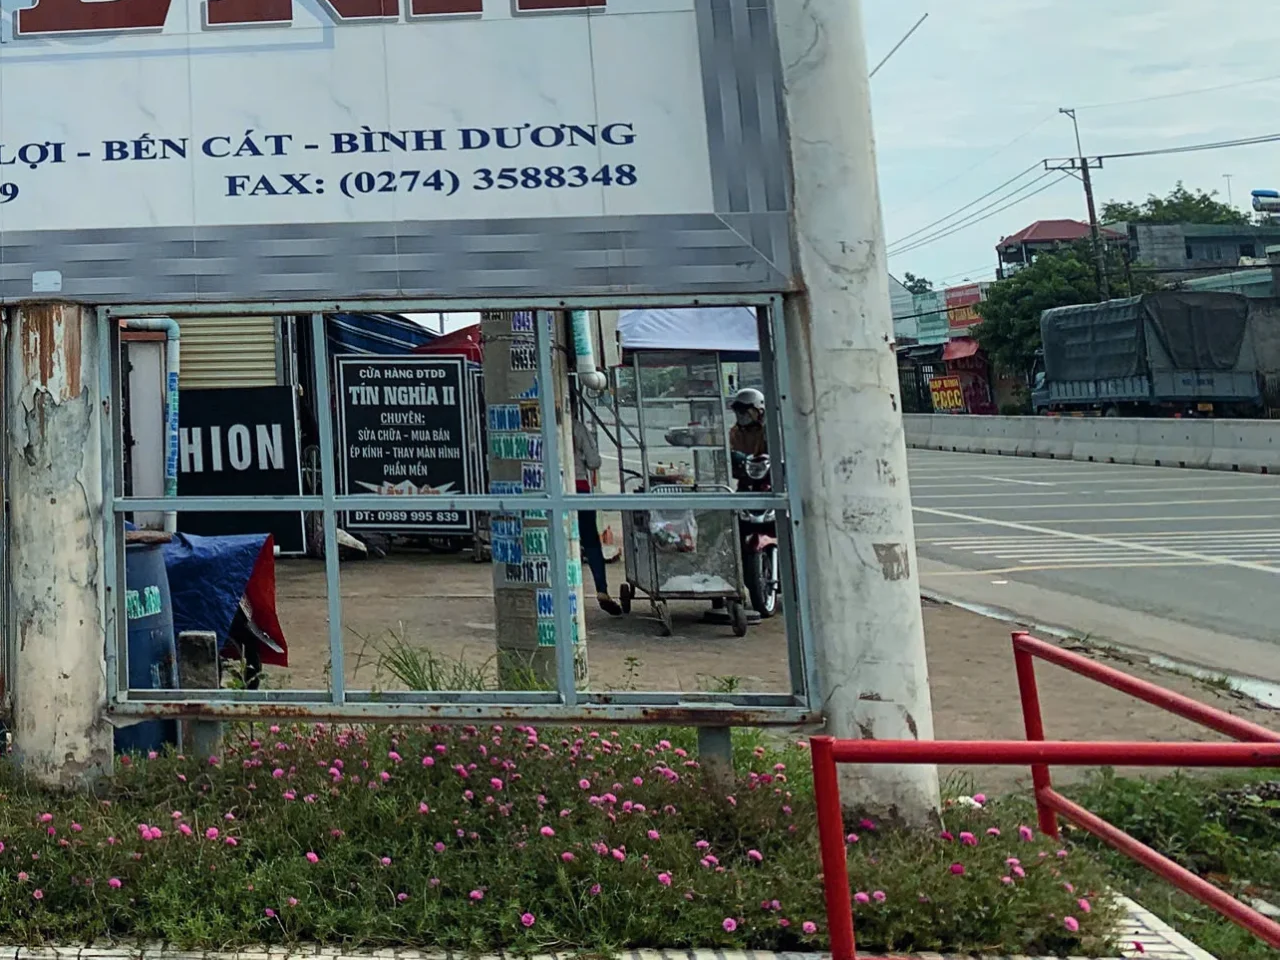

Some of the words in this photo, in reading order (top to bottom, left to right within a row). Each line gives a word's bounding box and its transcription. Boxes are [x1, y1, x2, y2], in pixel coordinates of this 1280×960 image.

[102, 133, 189, 161] BẾN
[201, 130, 293, 158] CÁT
[331, 126, 447, 154] BÌNH
[458, 122, 638, 151] DƯƠNG
[224, 172, 325, 197] FAX:
[338, 168, 461, 200] (0274)
[472, 163, 638, 191] 3588348
[359, 366, 381, 379] CỬA
[384, 367, 414, 379] HÀNG
[348, 382, 380, 406] TÍN
[442, 386, 456, 406] II
[380, 410, 426, 425] CHUYÊN:
[410, 429, 431, 441] MUA
[432, 427, 450, 441] BÁN
[179, 423, 285, 473] HION
[362, 444, 383, 458] KÍNH
[392, 447, 414, 458] THAY
[416, 444, 436, 458] MÀN
[438, 444, 461, 459] HÌNH
[355, 511, 374, 521] ĐT:
[377, 511, 407, 522] 0989
[410, 511, 433, 522] 995
[436, 512, 459, 522] 839
